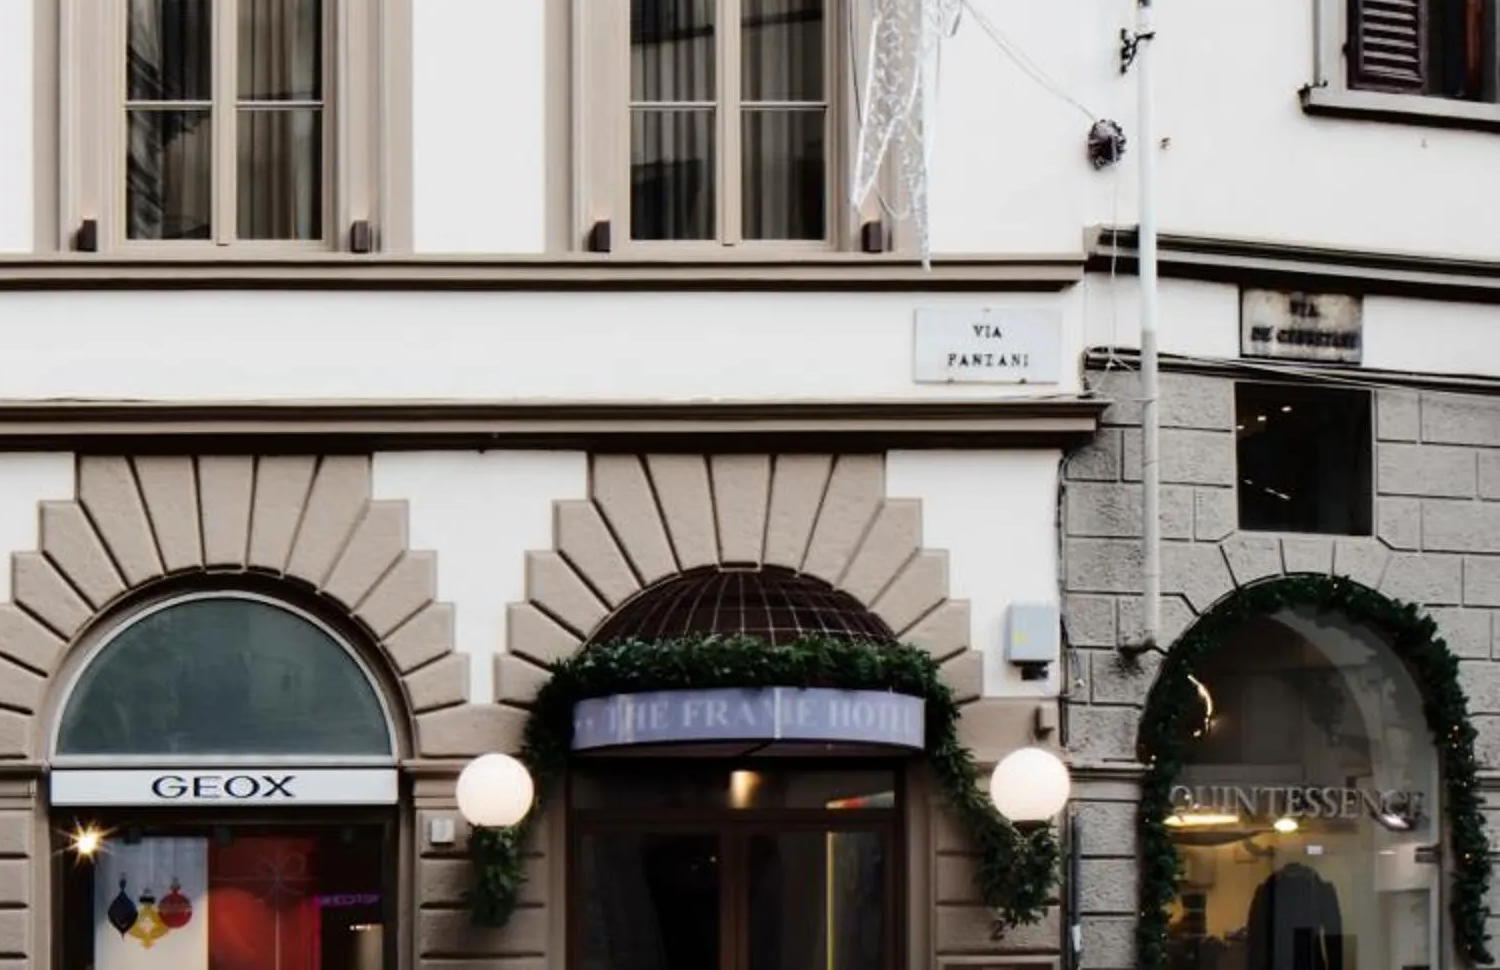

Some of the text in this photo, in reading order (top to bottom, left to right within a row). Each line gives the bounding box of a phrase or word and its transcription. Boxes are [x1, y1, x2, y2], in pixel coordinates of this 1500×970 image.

[973, 324, 1003, 339] VIA
[947, 352, 1030, 368] PANZANI
[151, 774, 296, 799] GEOX
[1168, 784, 1427, 822] QUINTESSENCE
